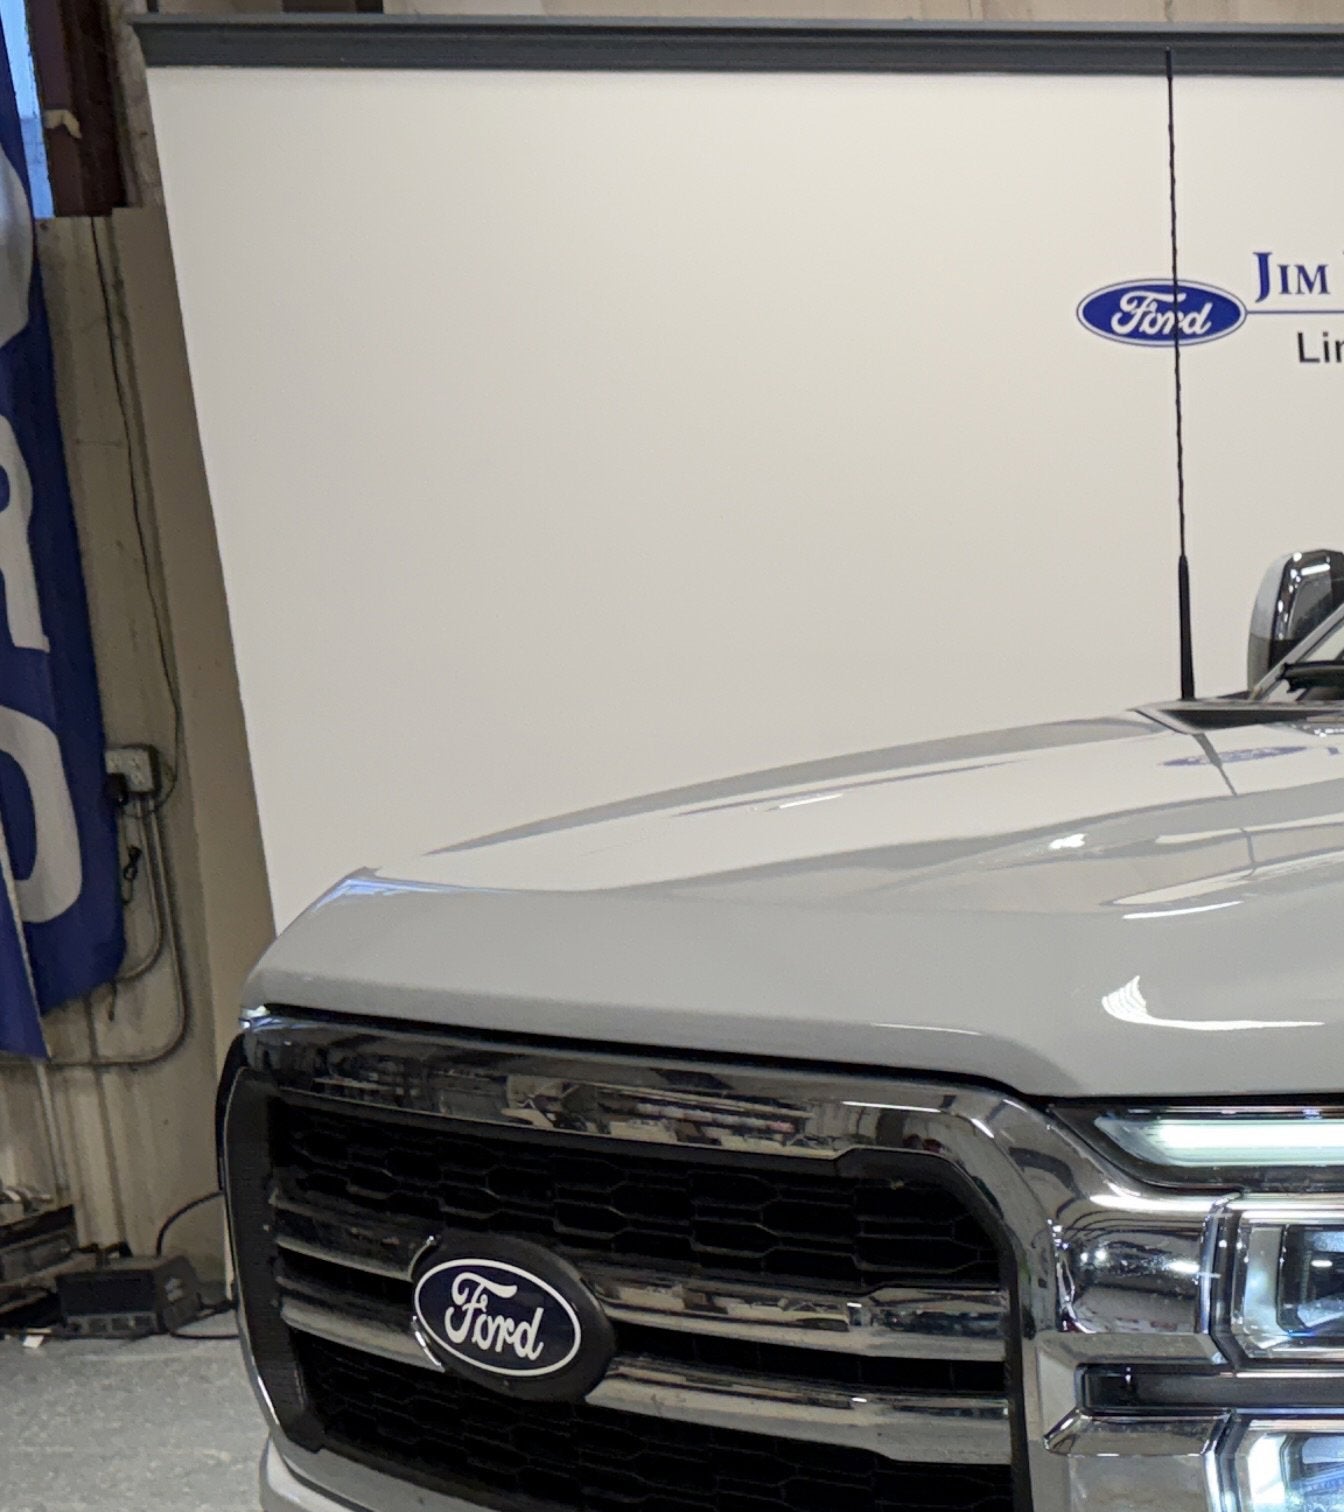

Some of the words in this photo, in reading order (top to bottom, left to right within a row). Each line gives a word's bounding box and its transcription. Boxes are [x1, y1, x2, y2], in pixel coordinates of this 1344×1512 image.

[1252, 250, 1330, 304] JIM
[1110, 290, 1213, 335] Ford
[444, 1271, 545, 1361] Ford
